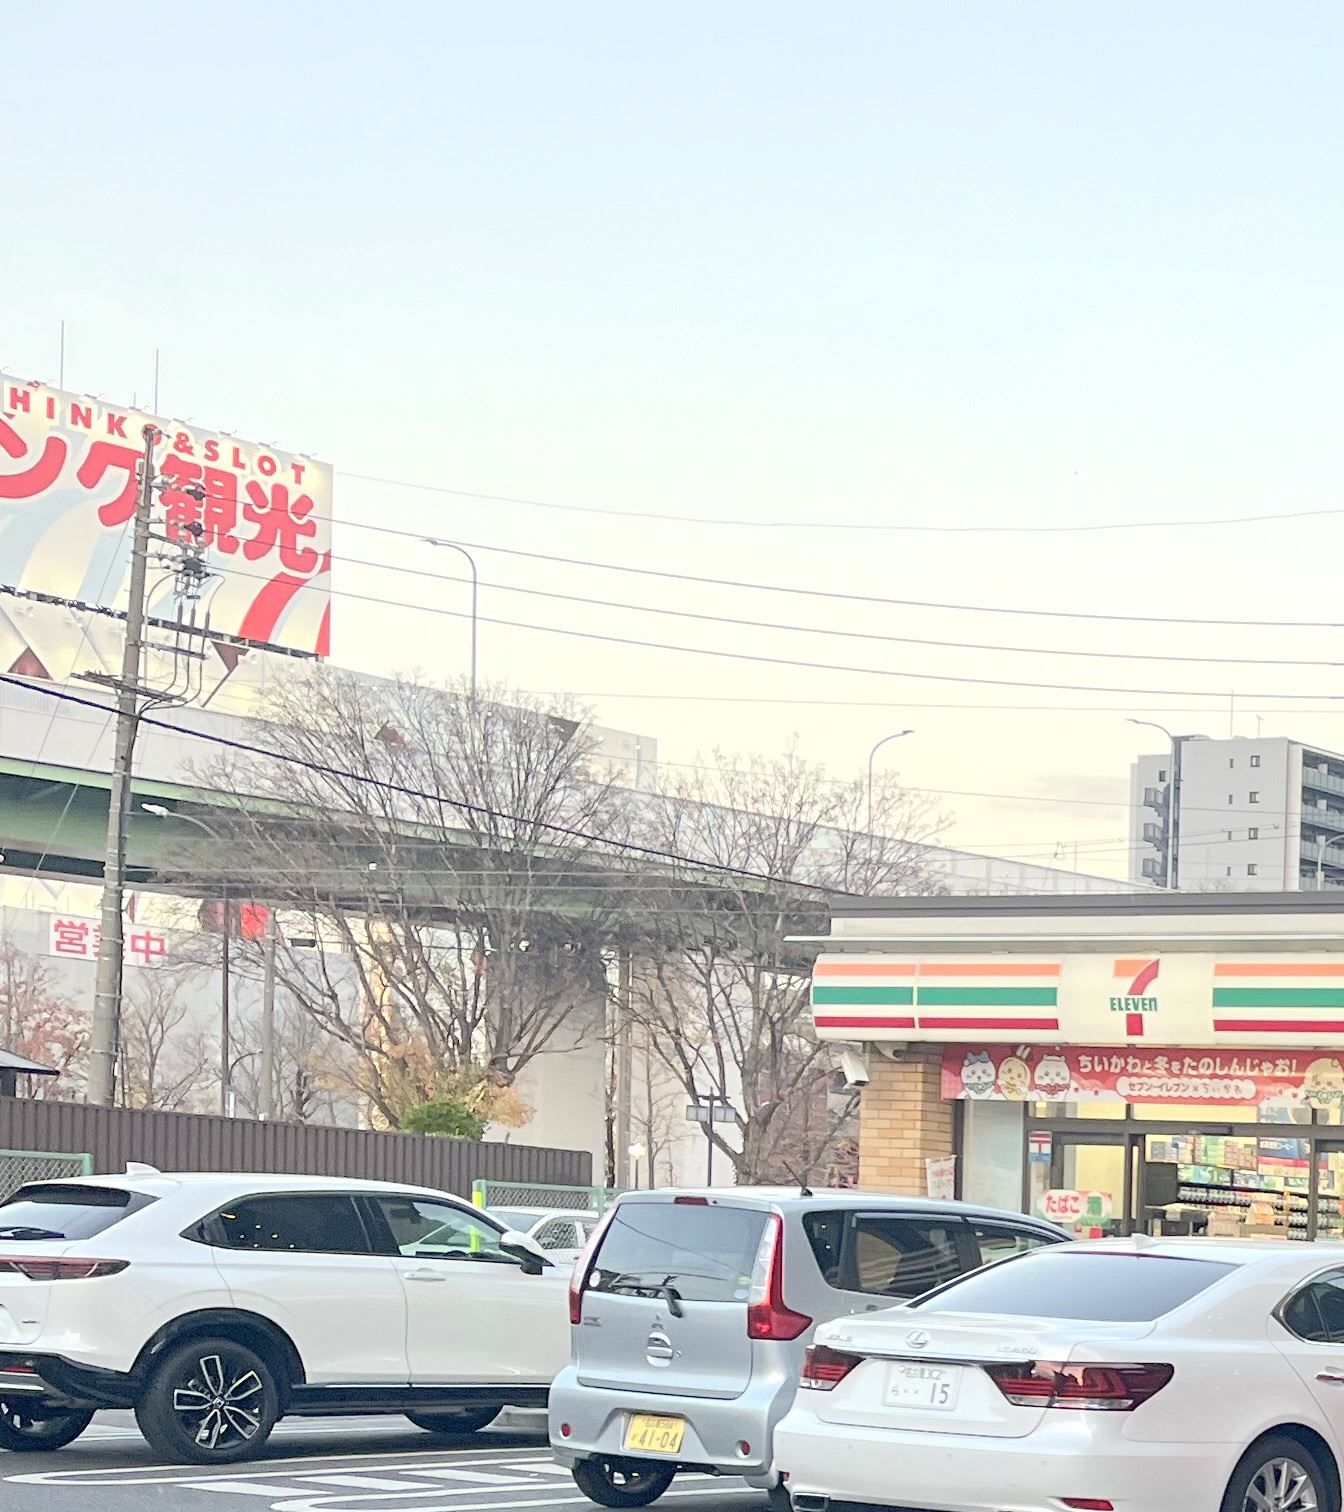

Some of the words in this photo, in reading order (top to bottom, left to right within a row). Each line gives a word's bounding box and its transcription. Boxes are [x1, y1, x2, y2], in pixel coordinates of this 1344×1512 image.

[1046, 1195, 1082, 1213] たばこ
[639, 1429, 678, 1450] 41-04
